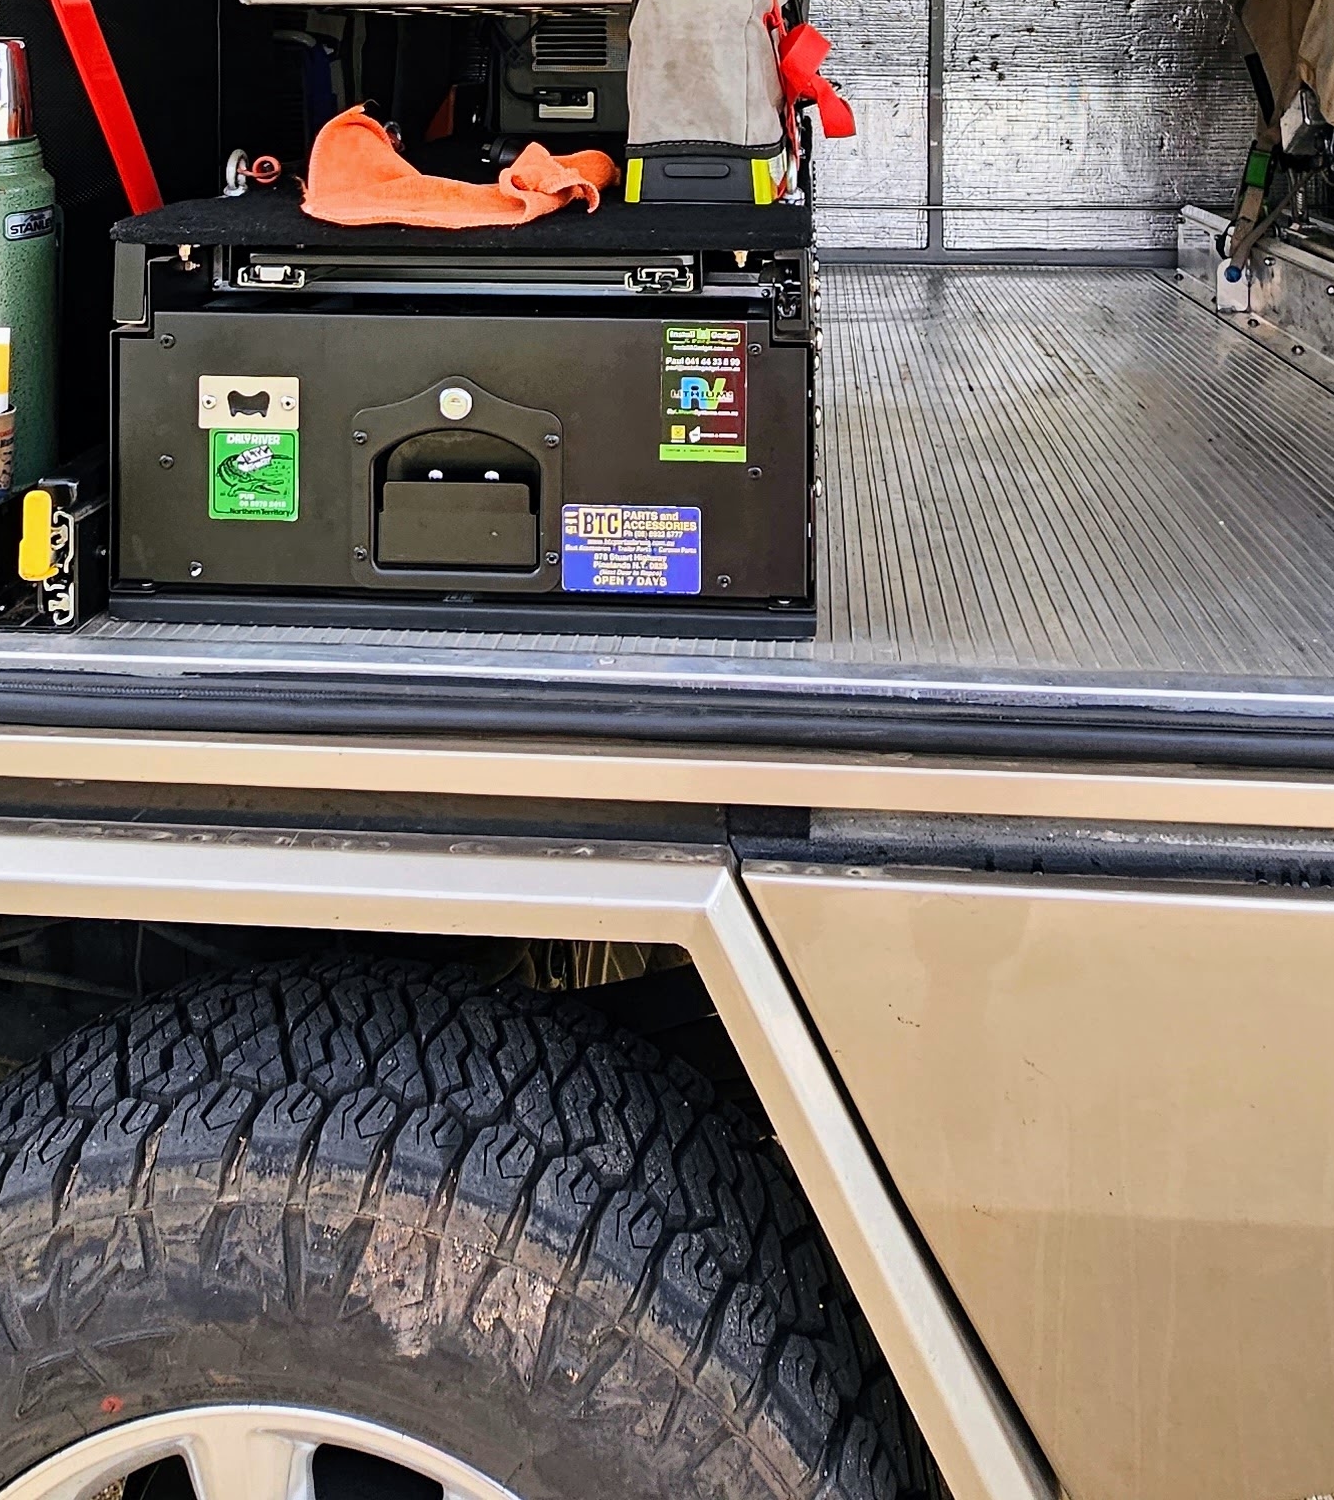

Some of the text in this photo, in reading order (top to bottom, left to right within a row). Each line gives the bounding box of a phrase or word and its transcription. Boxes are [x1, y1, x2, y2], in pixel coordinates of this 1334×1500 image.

[226, 433, 281, 445] DALY RIVER
[623, 510, 679, 521] PARTS and
[583, 512, 619, 535] BTC
[623, 520, 698, 531] ACCESSORIES
[593, 575, 667, 587] OPEN 7 DAYS
